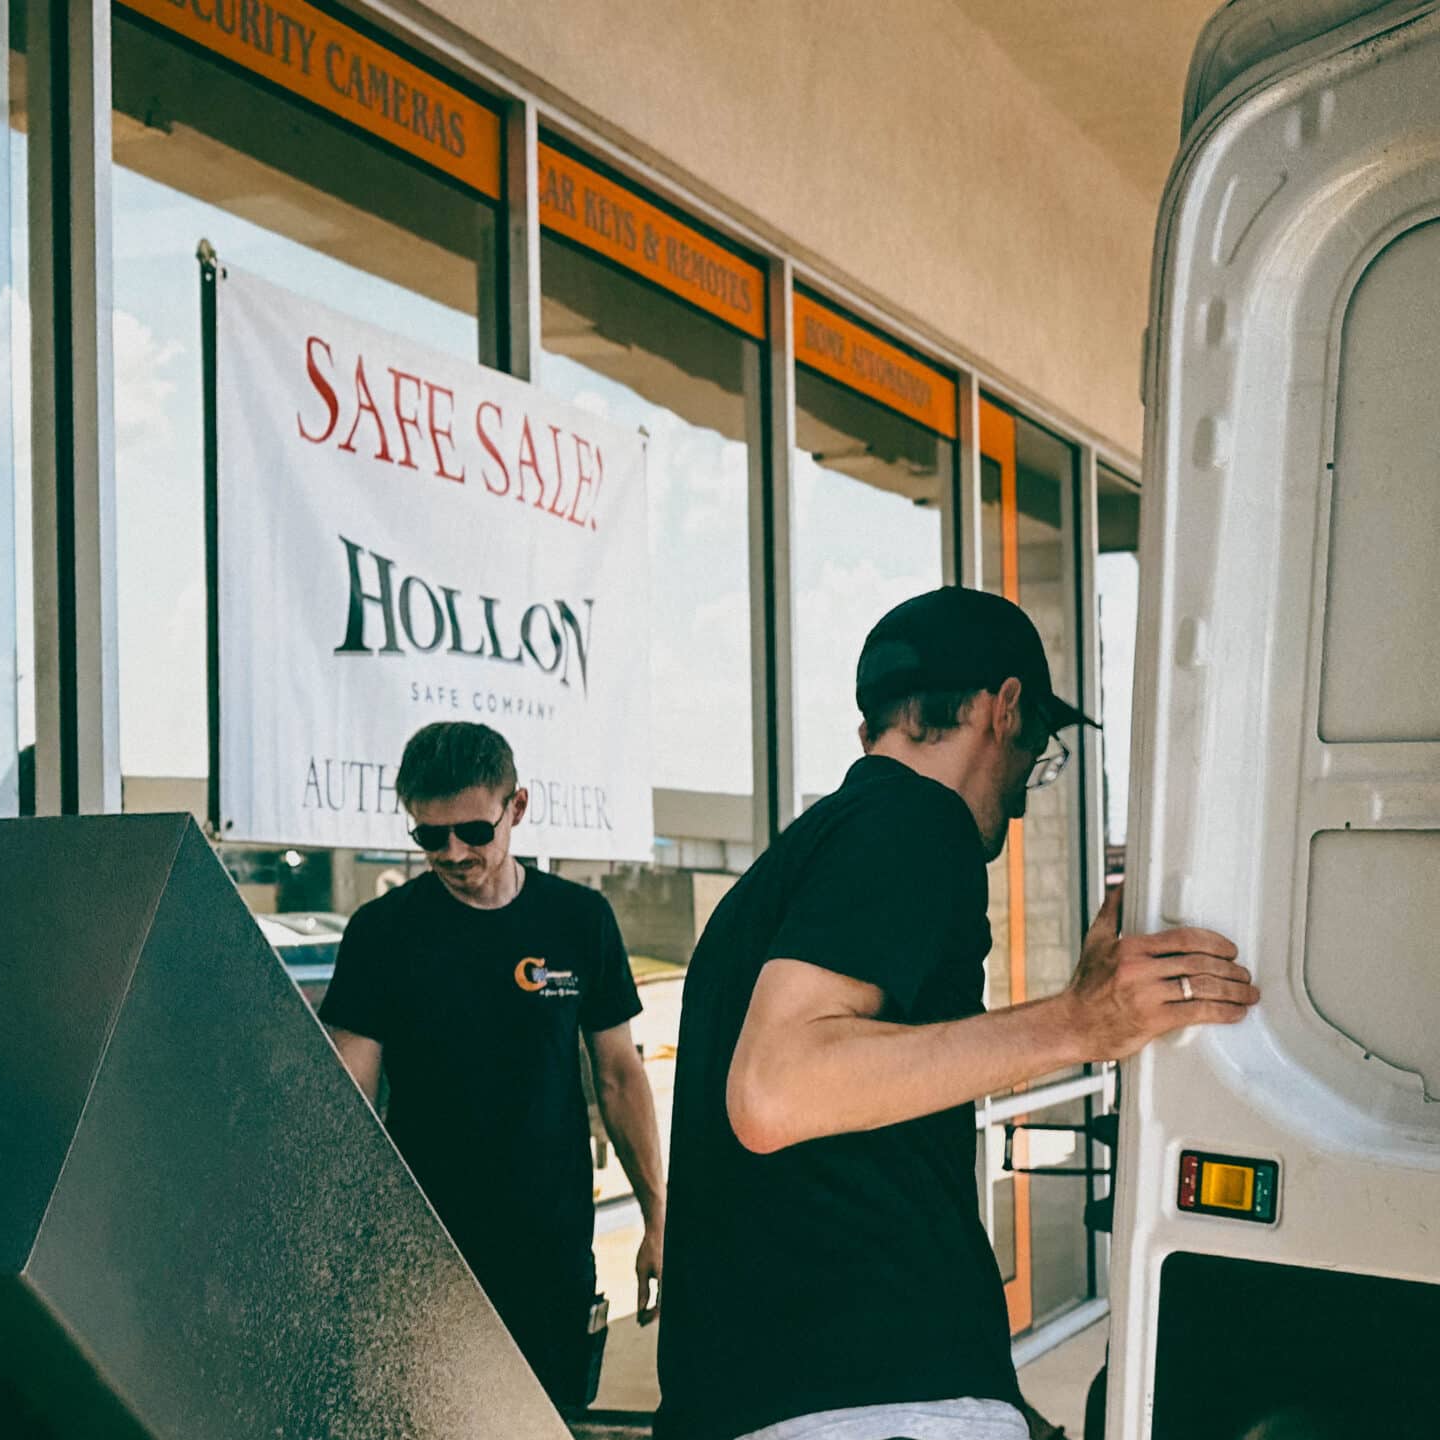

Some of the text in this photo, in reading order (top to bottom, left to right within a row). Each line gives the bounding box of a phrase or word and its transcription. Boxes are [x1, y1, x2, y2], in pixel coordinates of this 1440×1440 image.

[324, 40, 467, 160] CAMERAS
[538, 160, 753, 315] AR KEYS & REMOTES
[297, 335, 604, 532] SAFE SALE!
[332, 533, 595, 700] HOLLON
[410, 681, 556, 721] SAFE COMPANY
